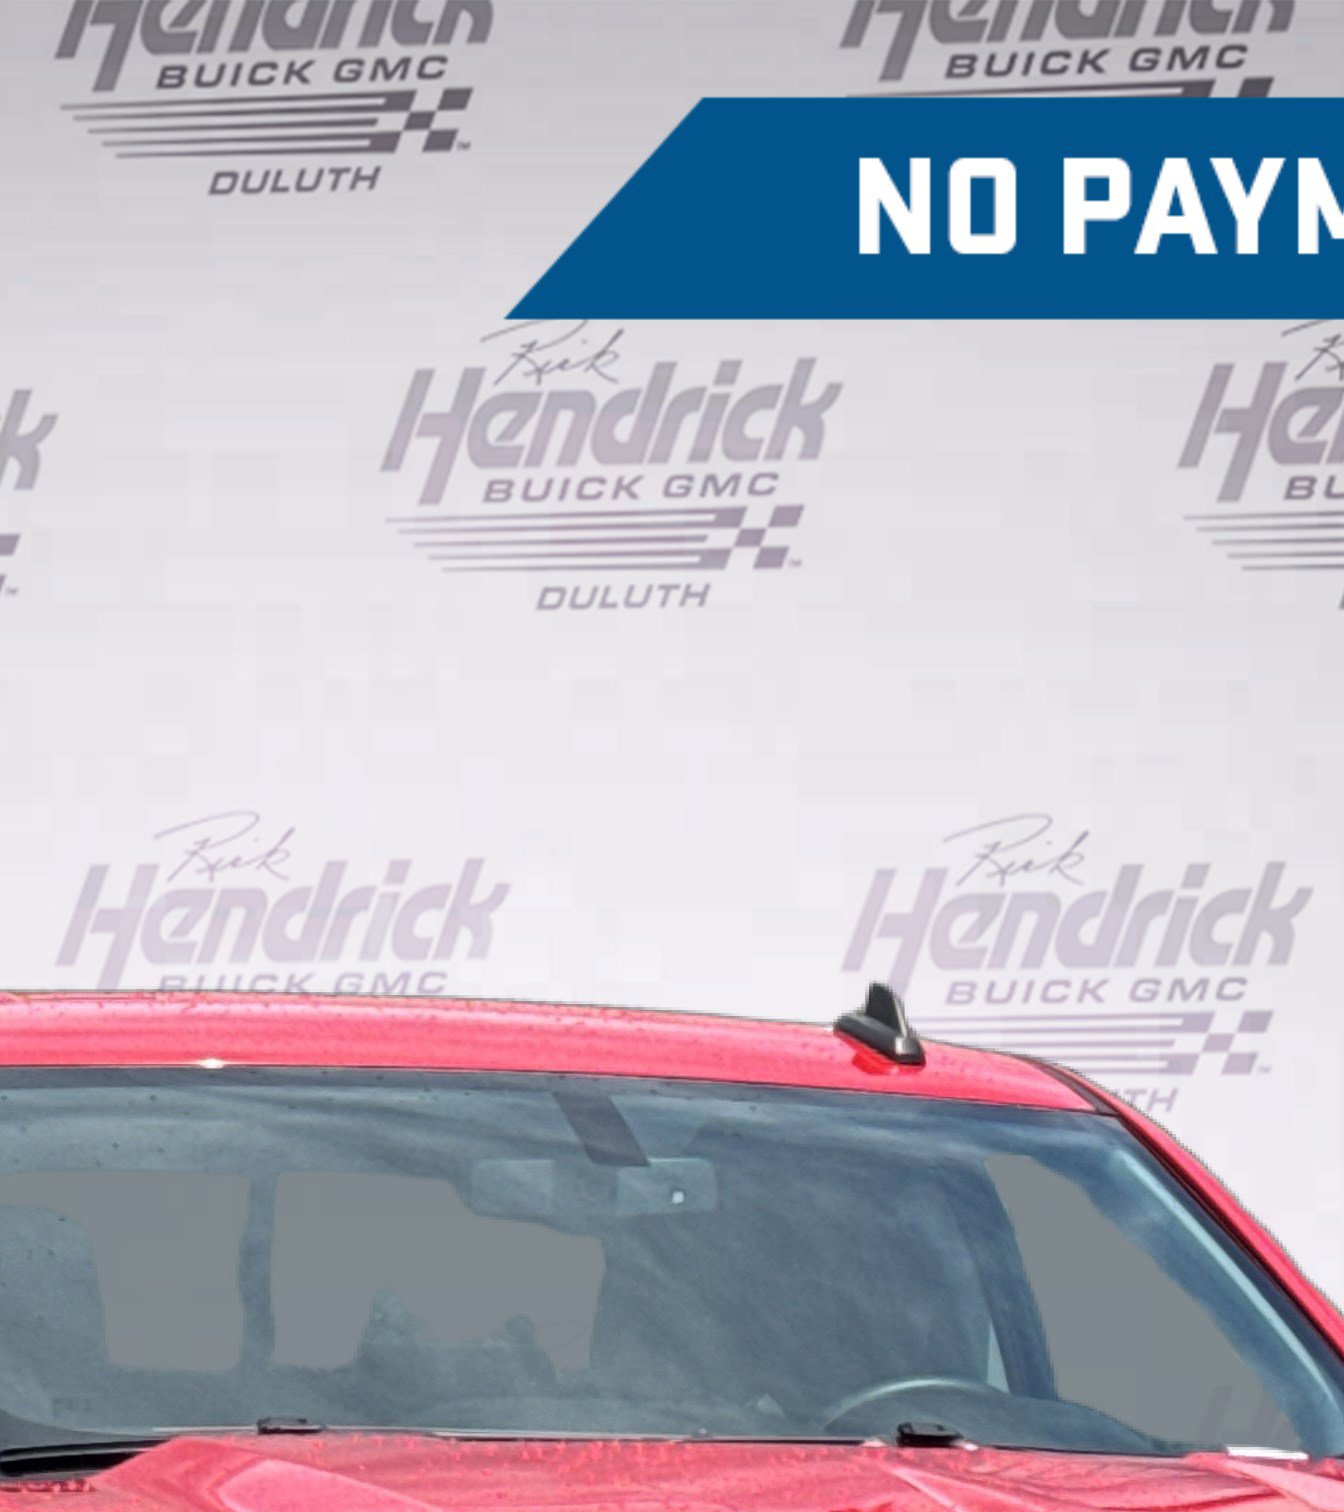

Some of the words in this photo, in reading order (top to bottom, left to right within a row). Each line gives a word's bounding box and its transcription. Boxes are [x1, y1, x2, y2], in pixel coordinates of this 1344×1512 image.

[155, 60, 315, 89] BUICK
[333, 56, 448, 82] GMC
[944, 49, 1110, 79] BUICK
[1128, 44, 1248, 71] GMC
[209, 166, 381, 195] DULUTH
[379, 356, 843, 505] Hendrick
[481, 473, 650, 505] BUICK
[660, 470, 779, 500] GMC
[535, 582, 713, 611] DULUTH
[55, 858, 511, 992] Hendrick
[840, 861, 1314, 1006] Hendrick
[158, 973, 315, 993] BUICK
[333, 971, 449, 995] GMC
[945, 980, 1109, 1005] BUICK
[1129, 977, 1248, 1002] GMC
